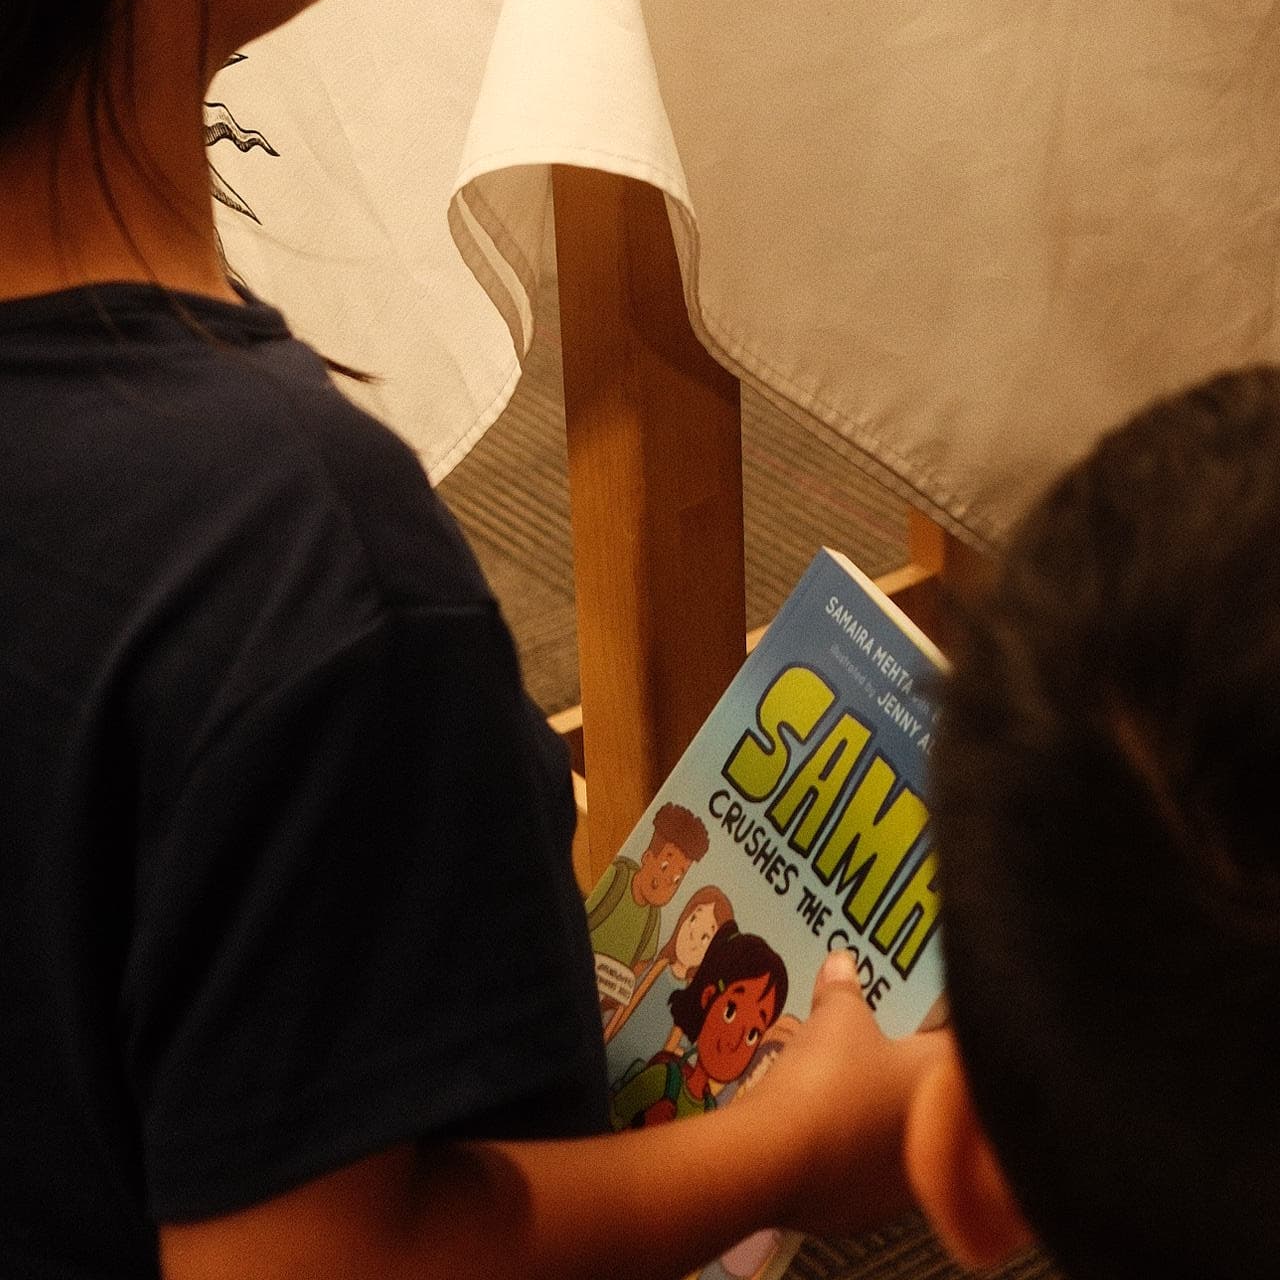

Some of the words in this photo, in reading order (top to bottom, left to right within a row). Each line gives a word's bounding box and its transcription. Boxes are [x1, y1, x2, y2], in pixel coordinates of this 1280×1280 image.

[824, 596, 875, 656] SAMAIRA
[871, 646, 914, 695] MEHTA
[877, 692, 922, 738] JENNY
[916, 733, 937, 756] AL
[708, 790, 799, 895] CRUSHES
[796, 886, 832, 936] THE
